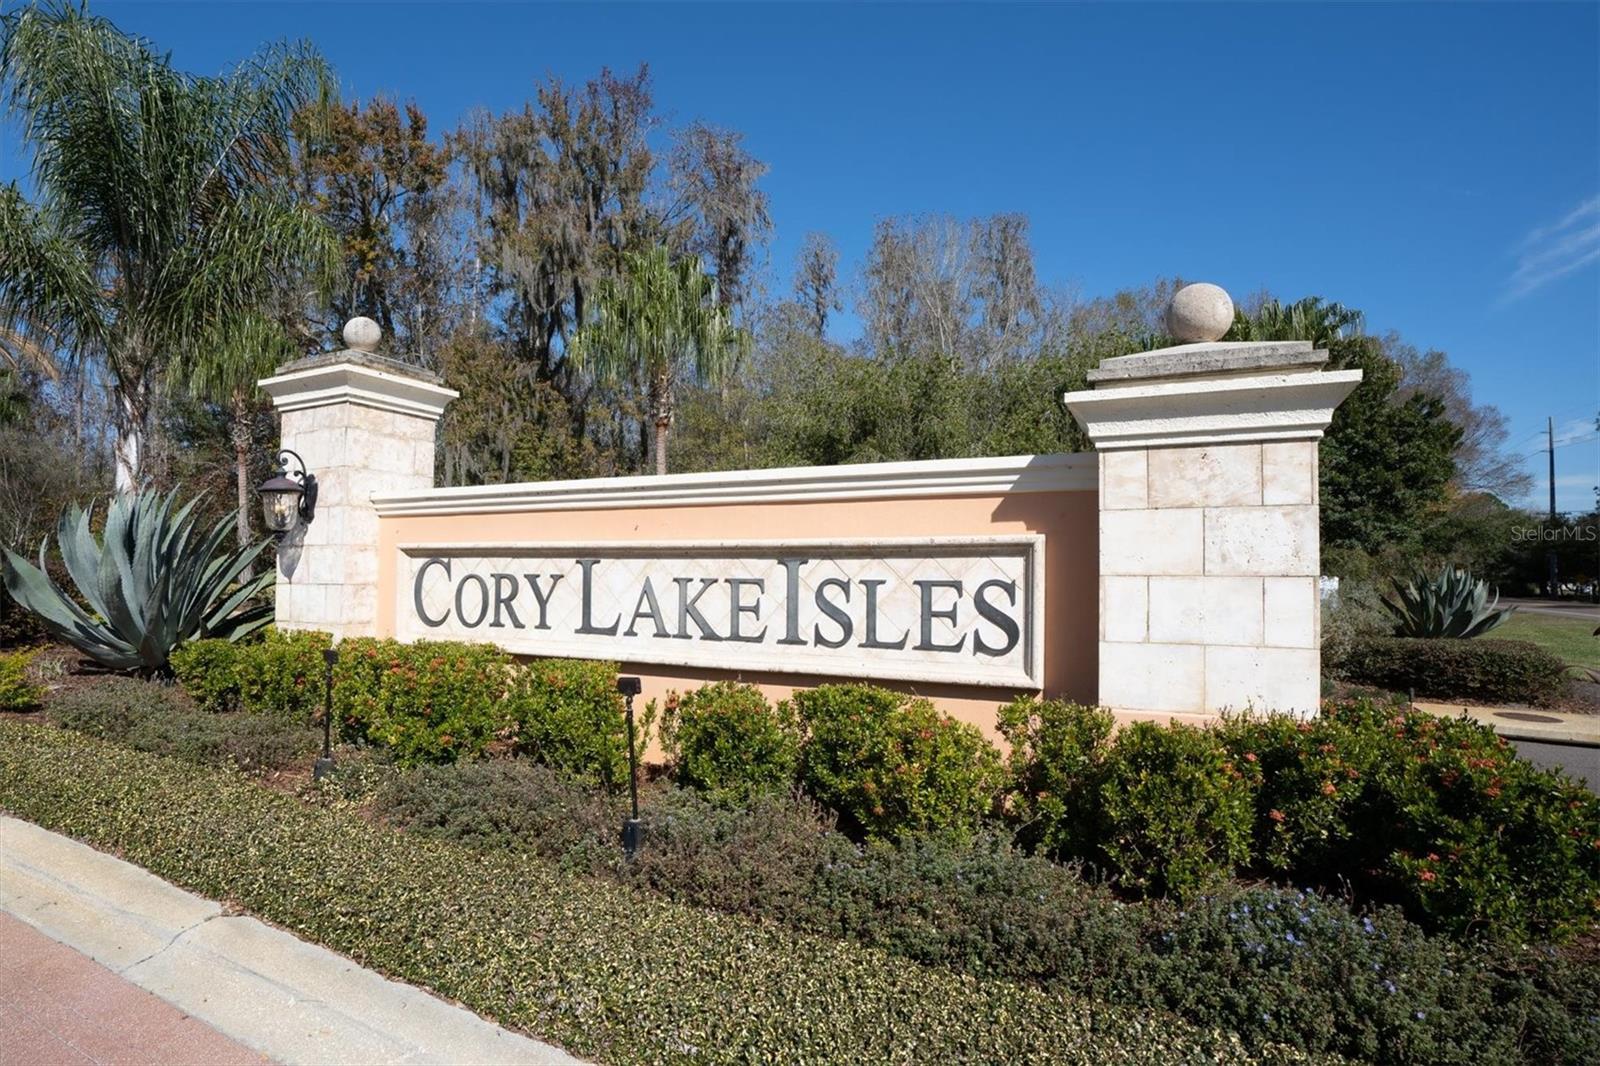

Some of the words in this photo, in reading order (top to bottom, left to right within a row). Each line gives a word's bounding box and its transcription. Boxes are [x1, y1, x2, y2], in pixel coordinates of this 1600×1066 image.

[414, 557, 564, 629] CORY
[575, 559, 767, 643] LAKE
[776, 557, 1020, 657] ISLES
